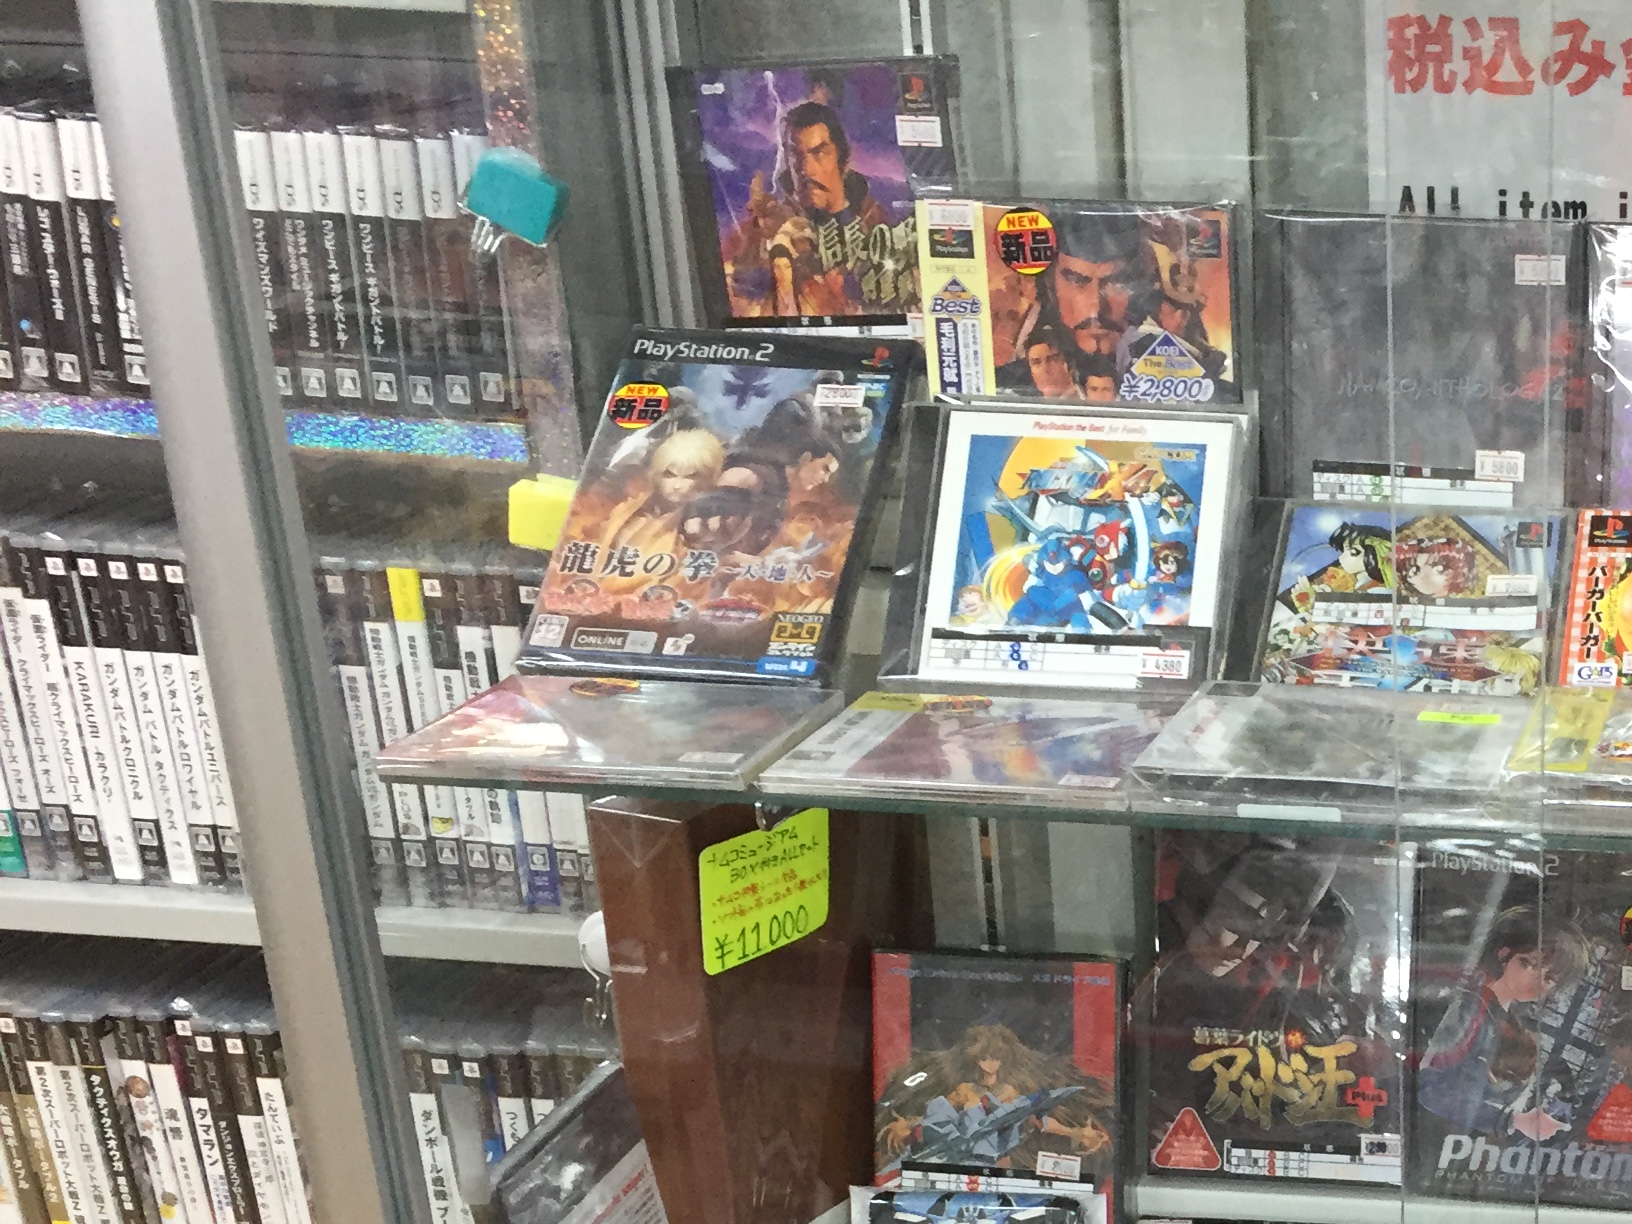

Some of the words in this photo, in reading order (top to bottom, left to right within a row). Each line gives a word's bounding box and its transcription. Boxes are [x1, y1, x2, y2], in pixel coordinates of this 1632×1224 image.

[1006, 215, 1040, 228] NEW
[1000, 231, 1055, 265] 新品
[930, 296, 982, 315] Best
[625, 385, 661, 396] NEW
[610, 397, 668, 423] 新品
[558, 540, 721, 581] 龍虎の拳
[1580, 564, 1609, 660] バーガーバーガー
[577, 633, 625, 647] ONLINE
[714, 904, 809, 969] ¥11000
[196, 1108, 218, 1165] タマラン
